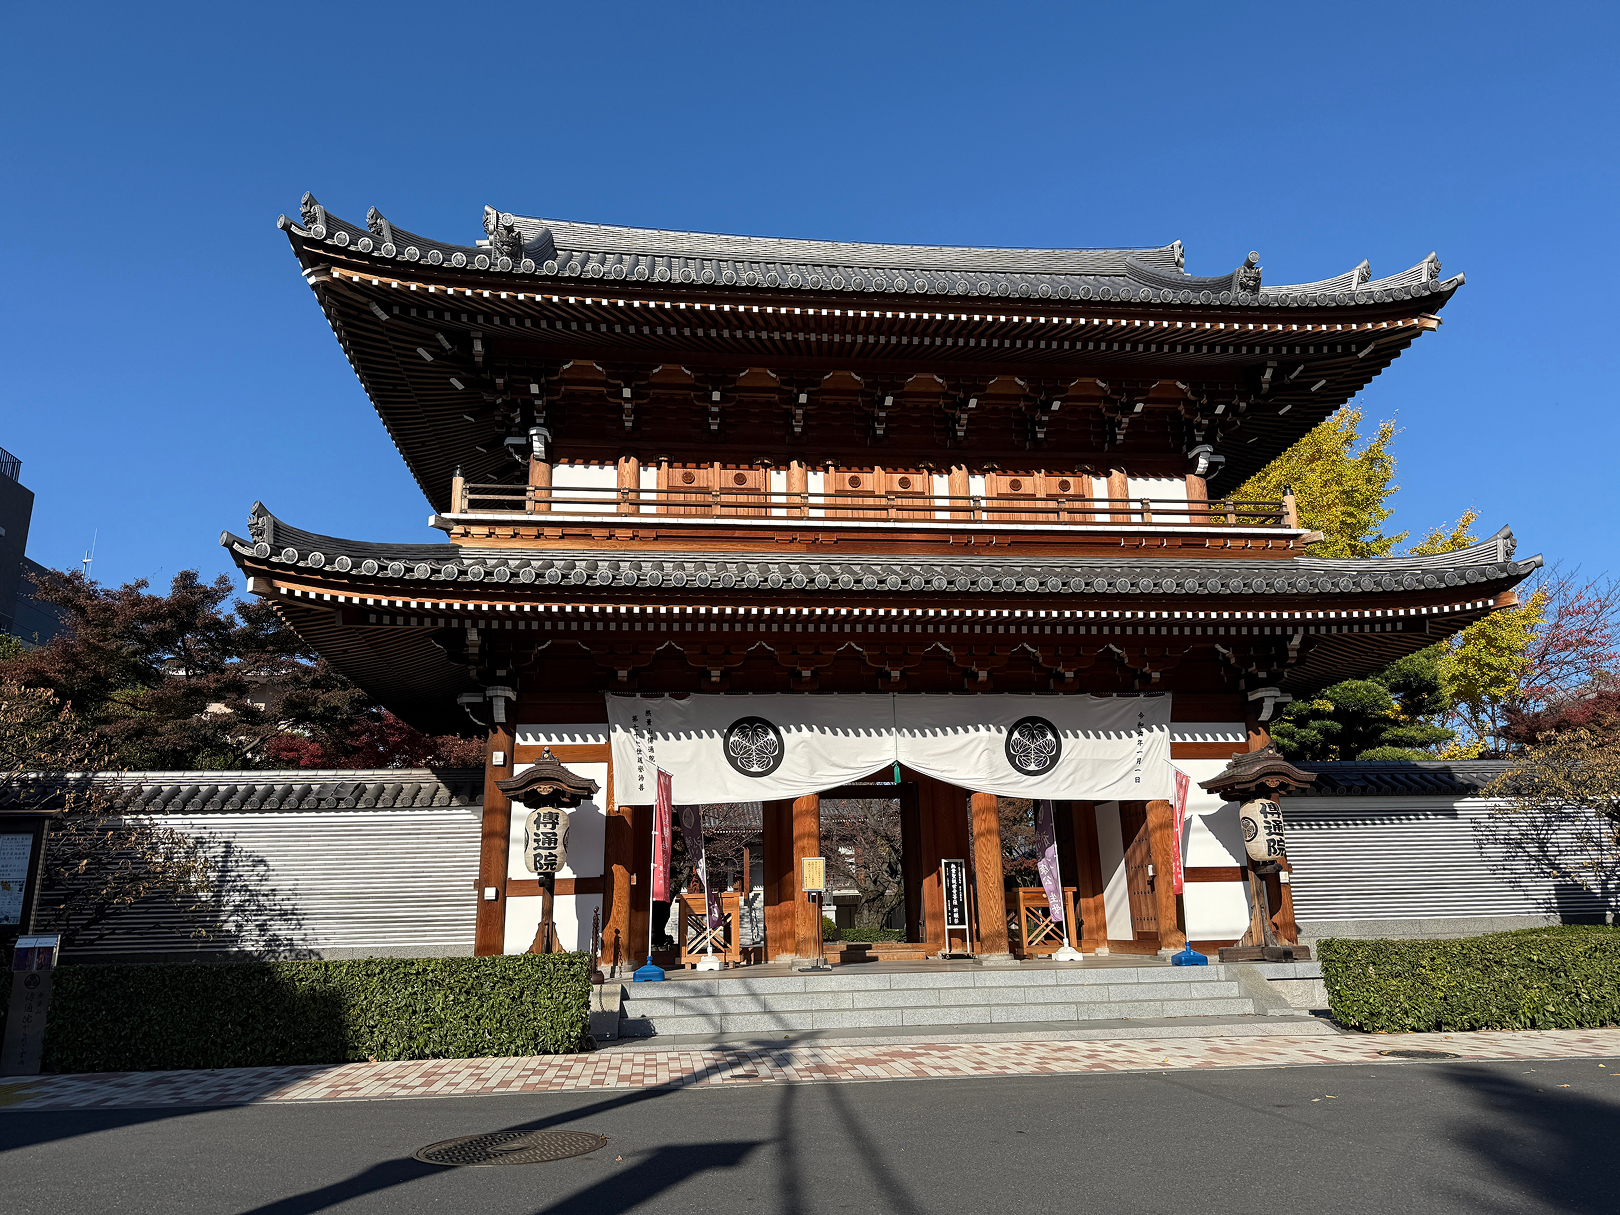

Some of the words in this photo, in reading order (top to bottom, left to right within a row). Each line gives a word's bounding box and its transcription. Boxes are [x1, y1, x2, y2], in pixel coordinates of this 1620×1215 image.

[533, 811, 560, 871] 傳通院
[1259, 802, 1286, 857] 傳通院
